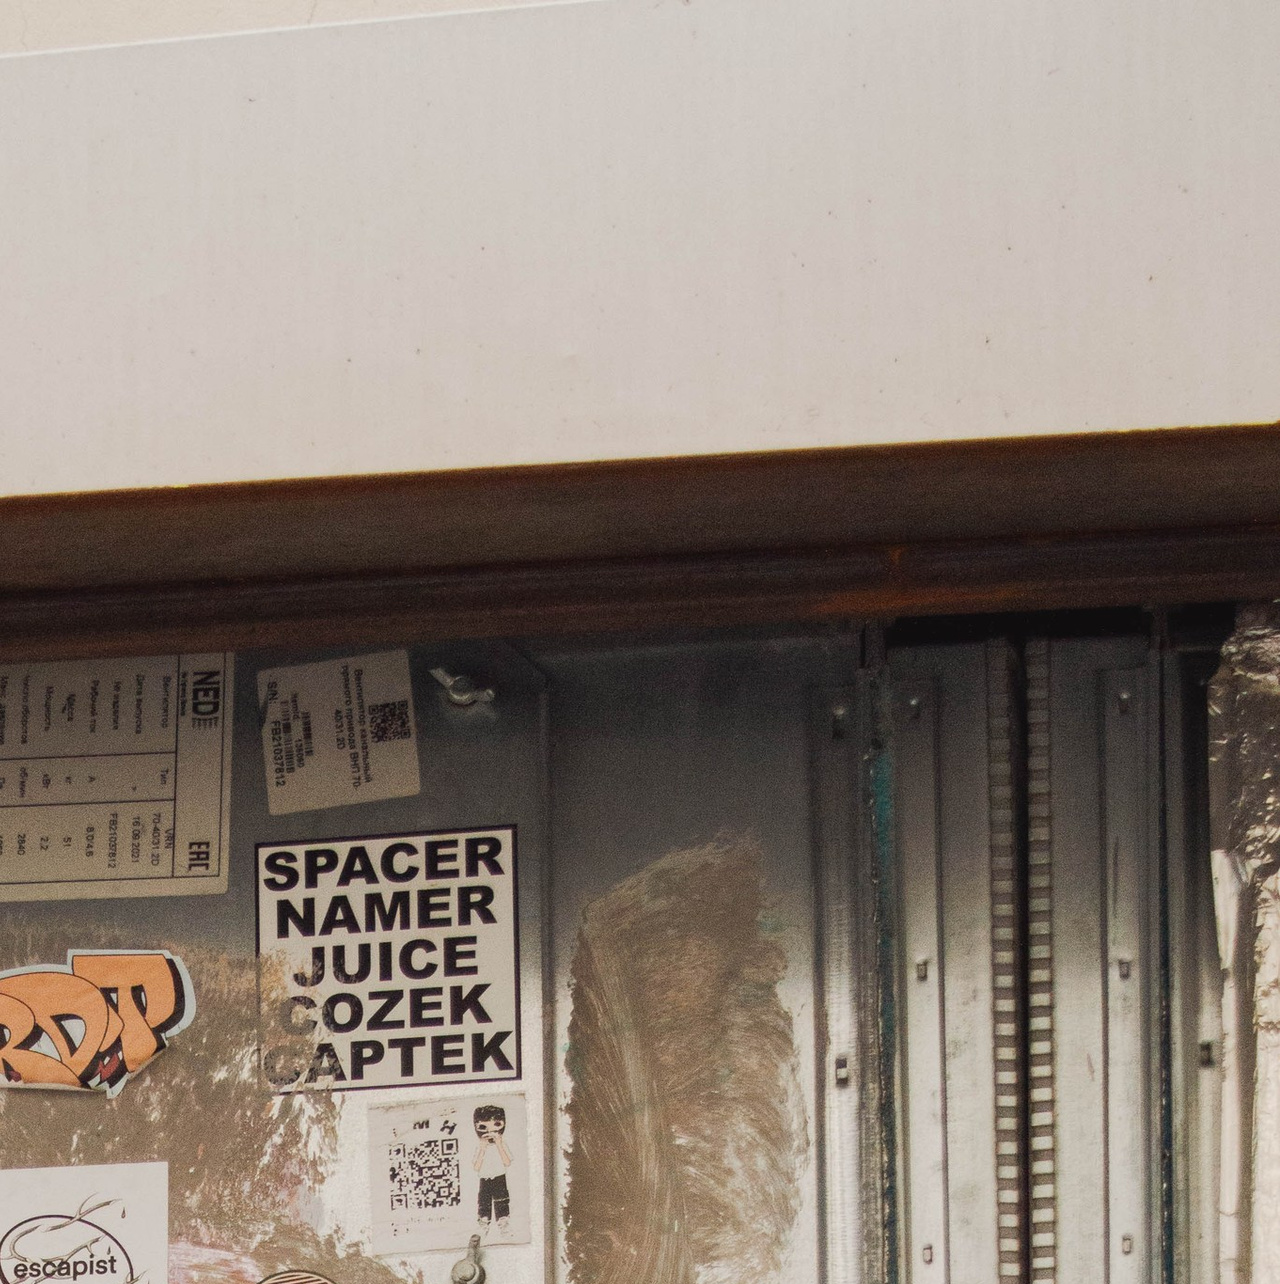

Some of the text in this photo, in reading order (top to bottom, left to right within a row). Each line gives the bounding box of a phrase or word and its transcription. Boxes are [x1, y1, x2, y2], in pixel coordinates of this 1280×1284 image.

[353, 669, 367, 726] Вентилятор
[270, 720, 286, 788] FB21037812
[263, 836, 506, 892] SPACER
[276, 885, 498, 939] NAMER
[292, 935, 479, 987] JUICE
[13, 1252, 118, 1281] escapist
